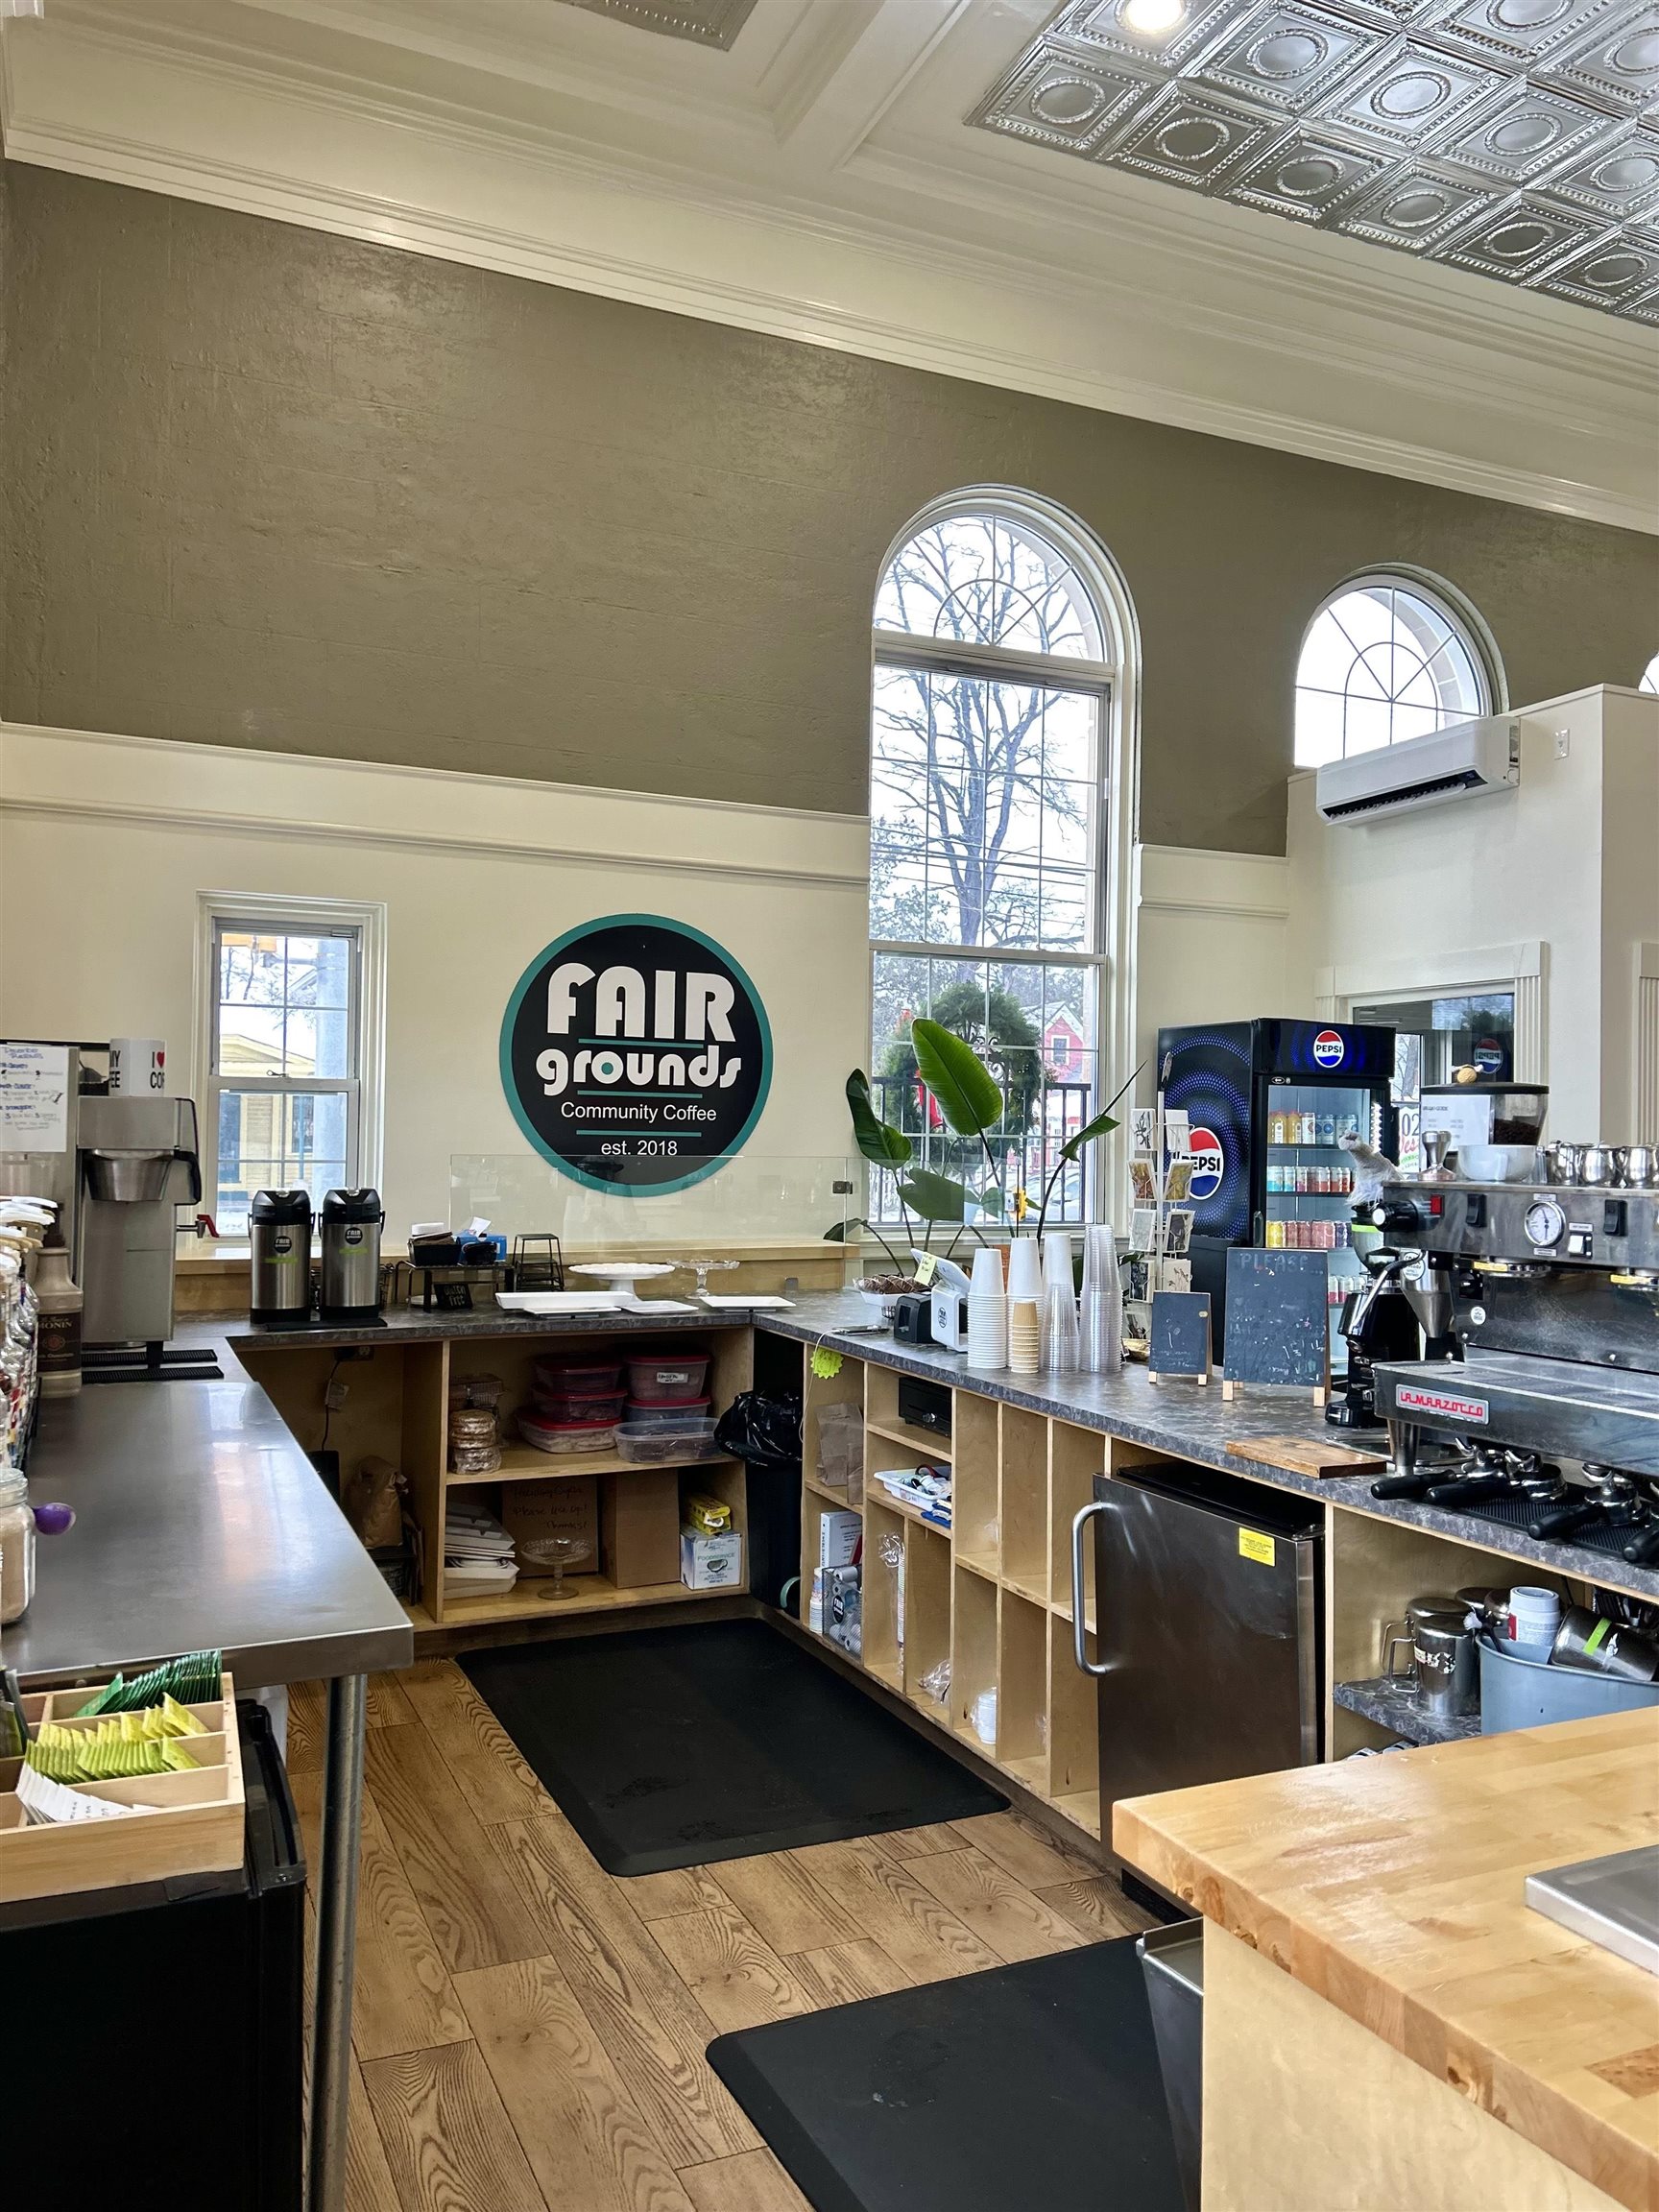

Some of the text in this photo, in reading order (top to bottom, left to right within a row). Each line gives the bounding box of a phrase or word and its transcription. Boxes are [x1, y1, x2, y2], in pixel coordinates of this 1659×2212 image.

[547, 962, 736, 1043] FAIR
[1315, 1045, 1342, 1053] PEPSI
[536, 1045, 742, 1096] grounds
[561, 1101, 717, 1123] Community Coffee
[601, 1140, 678, 1156] est. 2018
[1181, 1156, 1221, 1171] EPSI
